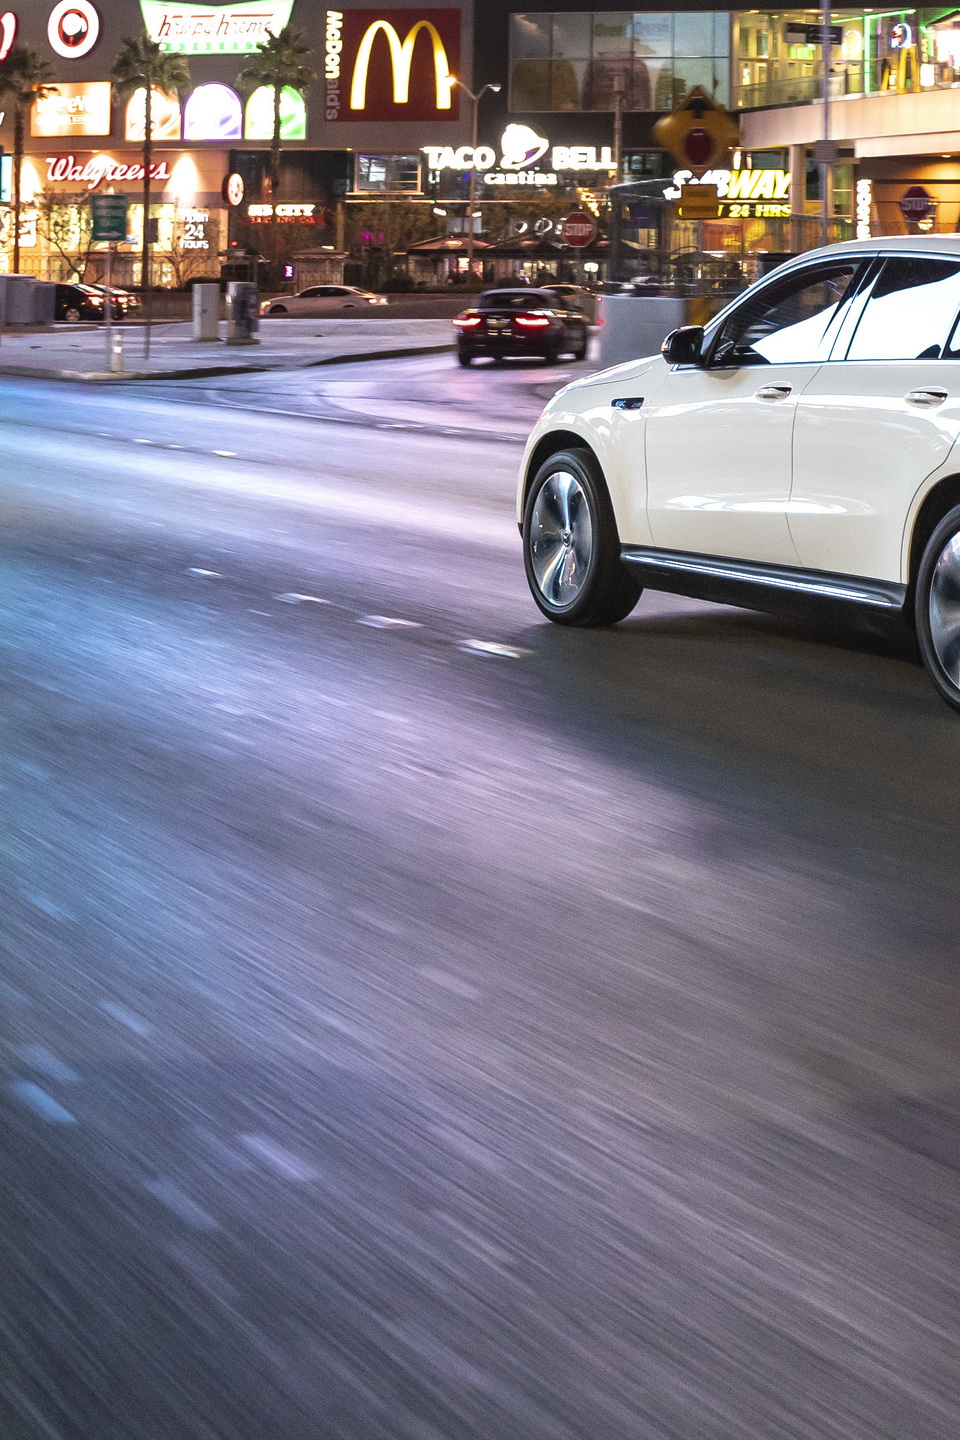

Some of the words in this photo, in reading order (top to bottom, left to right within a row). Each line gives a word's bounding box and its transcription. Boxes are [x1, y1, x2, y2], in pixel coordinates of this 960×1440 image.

[324, 10, 344, 120] McDonald's
[422, 146, 496, 169] TACO
[552, 146, 618, 170] BELL
[484, 172, 557, 185] cantina
[275, 204, 316, 217] CITY
[729, 205, 750, 218] 24
[755, 204, 792, 217] HRS
[184, 224, 205, 239] 24
[563, 223, 594, 237] STOP
[179, 238, 209, 250] hours
